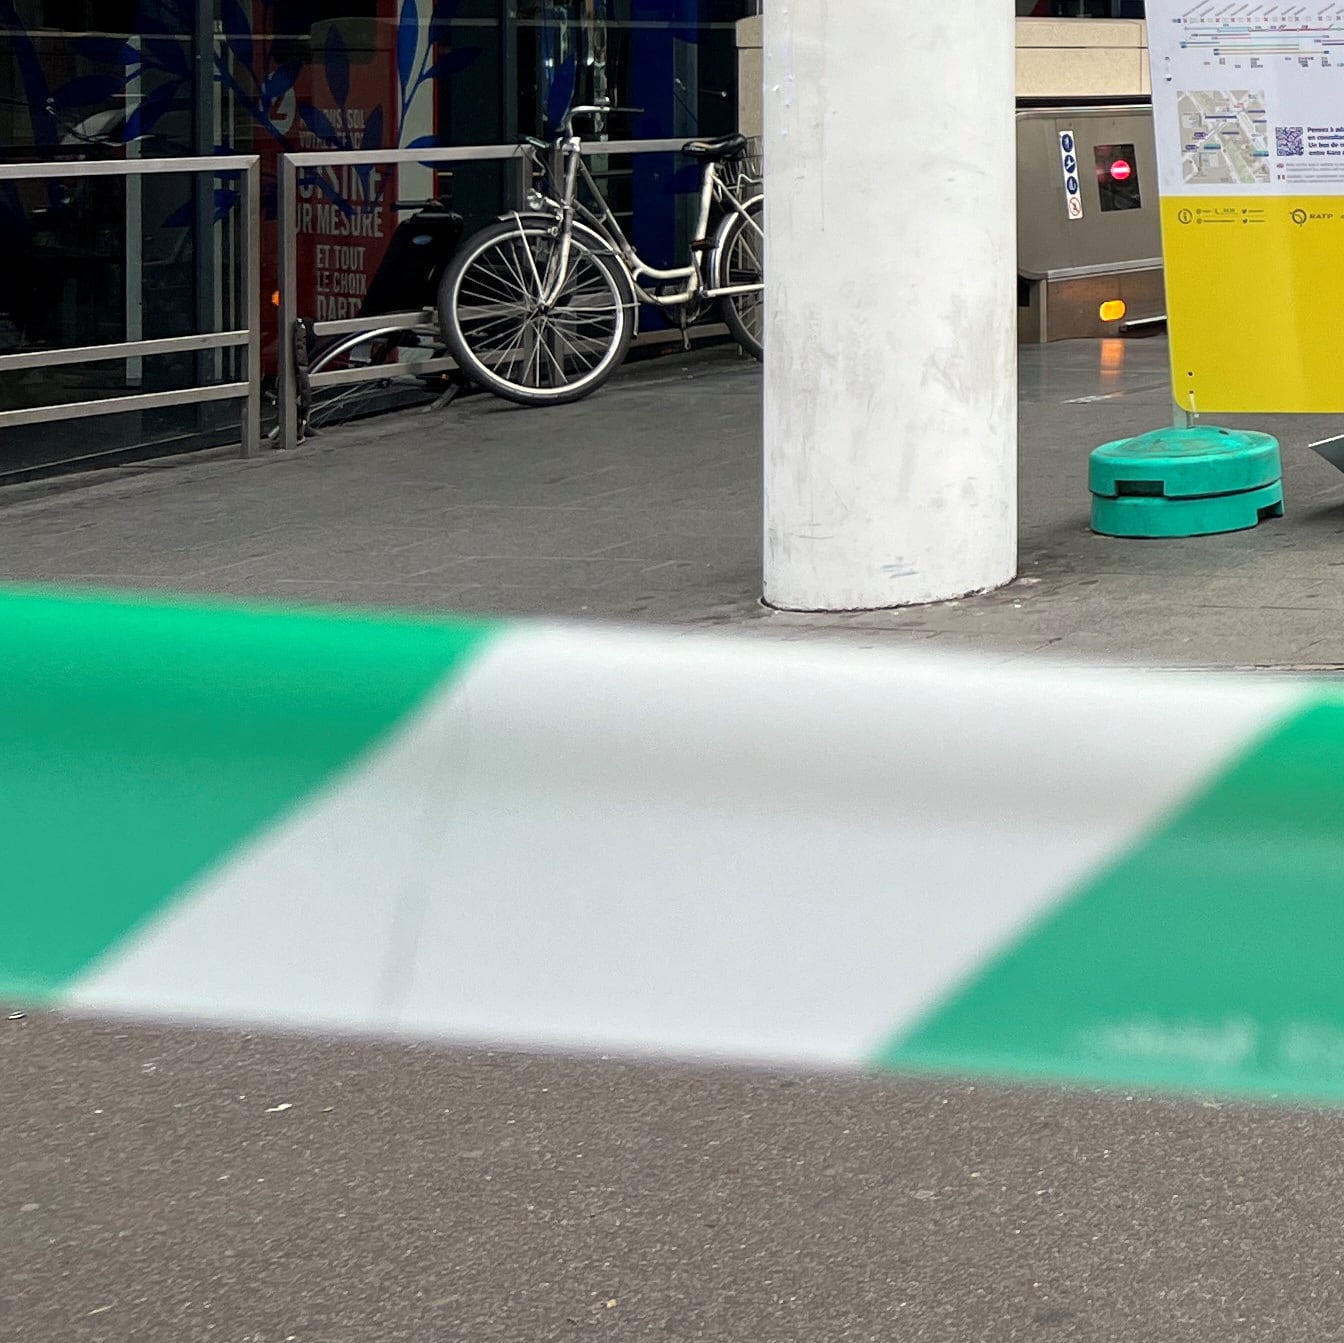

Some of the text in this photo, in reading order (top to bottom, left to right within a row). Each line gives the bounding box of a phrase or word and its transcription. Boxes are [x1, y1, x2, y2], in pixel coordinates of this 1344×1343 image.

[316, 245, 367, 272] ET TOUT
[316, 271, 367, 296] LE CHOIX
